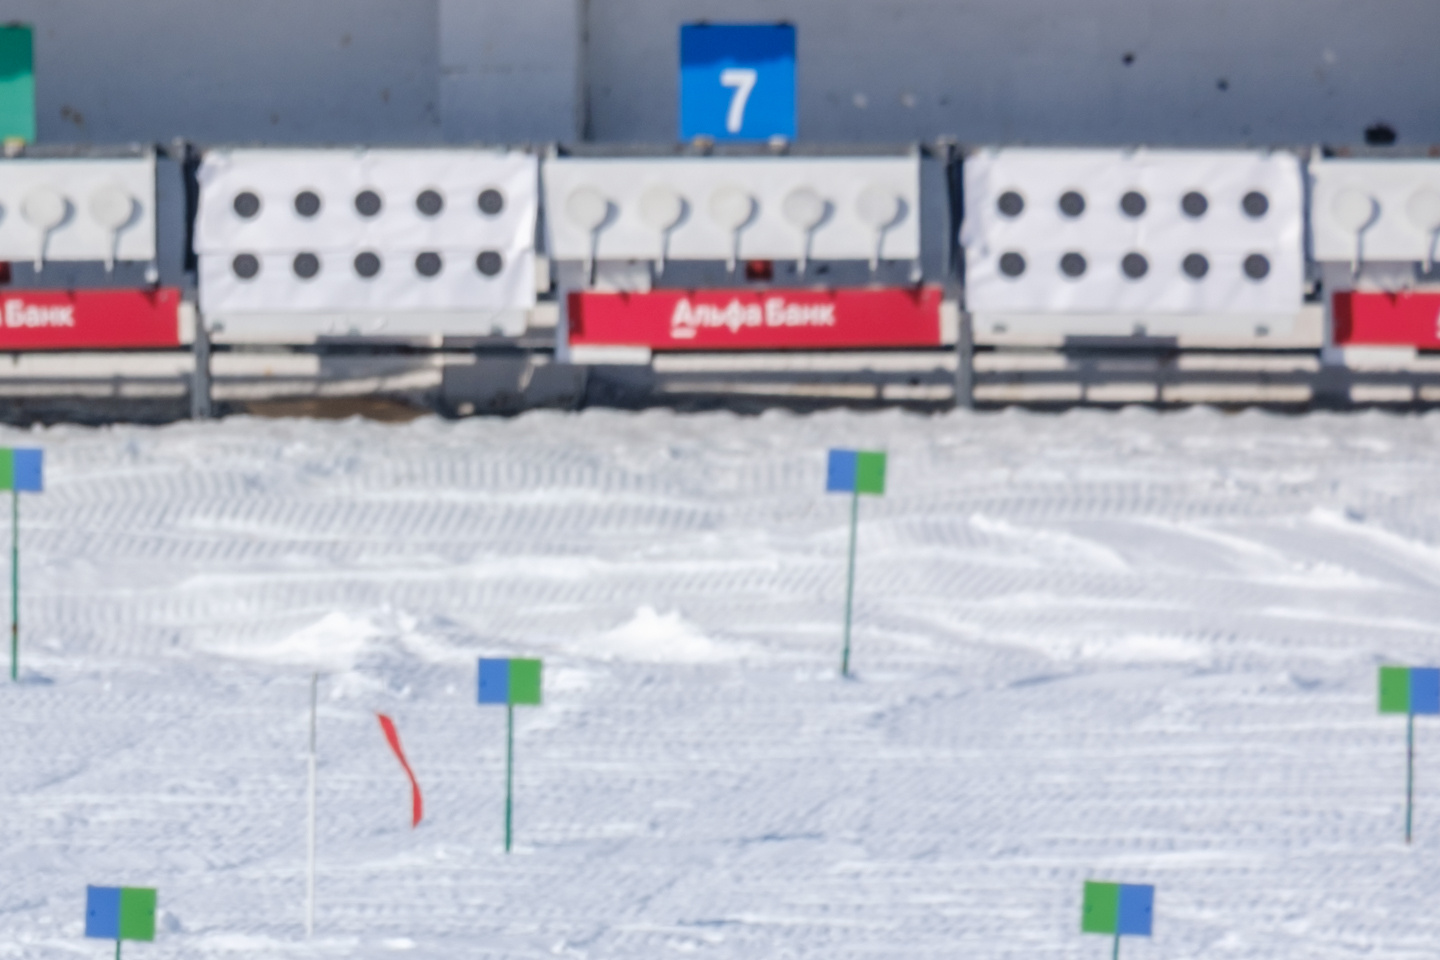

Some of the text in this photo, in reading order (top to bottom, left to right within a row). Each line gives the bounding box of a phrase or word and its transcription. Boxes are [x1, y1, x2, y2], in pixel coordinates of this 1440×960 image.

[720, 68, 757, 133] 7
[4, 299, 75, 327] Банк
[672, 298, 836, 334] Альфа Банк
